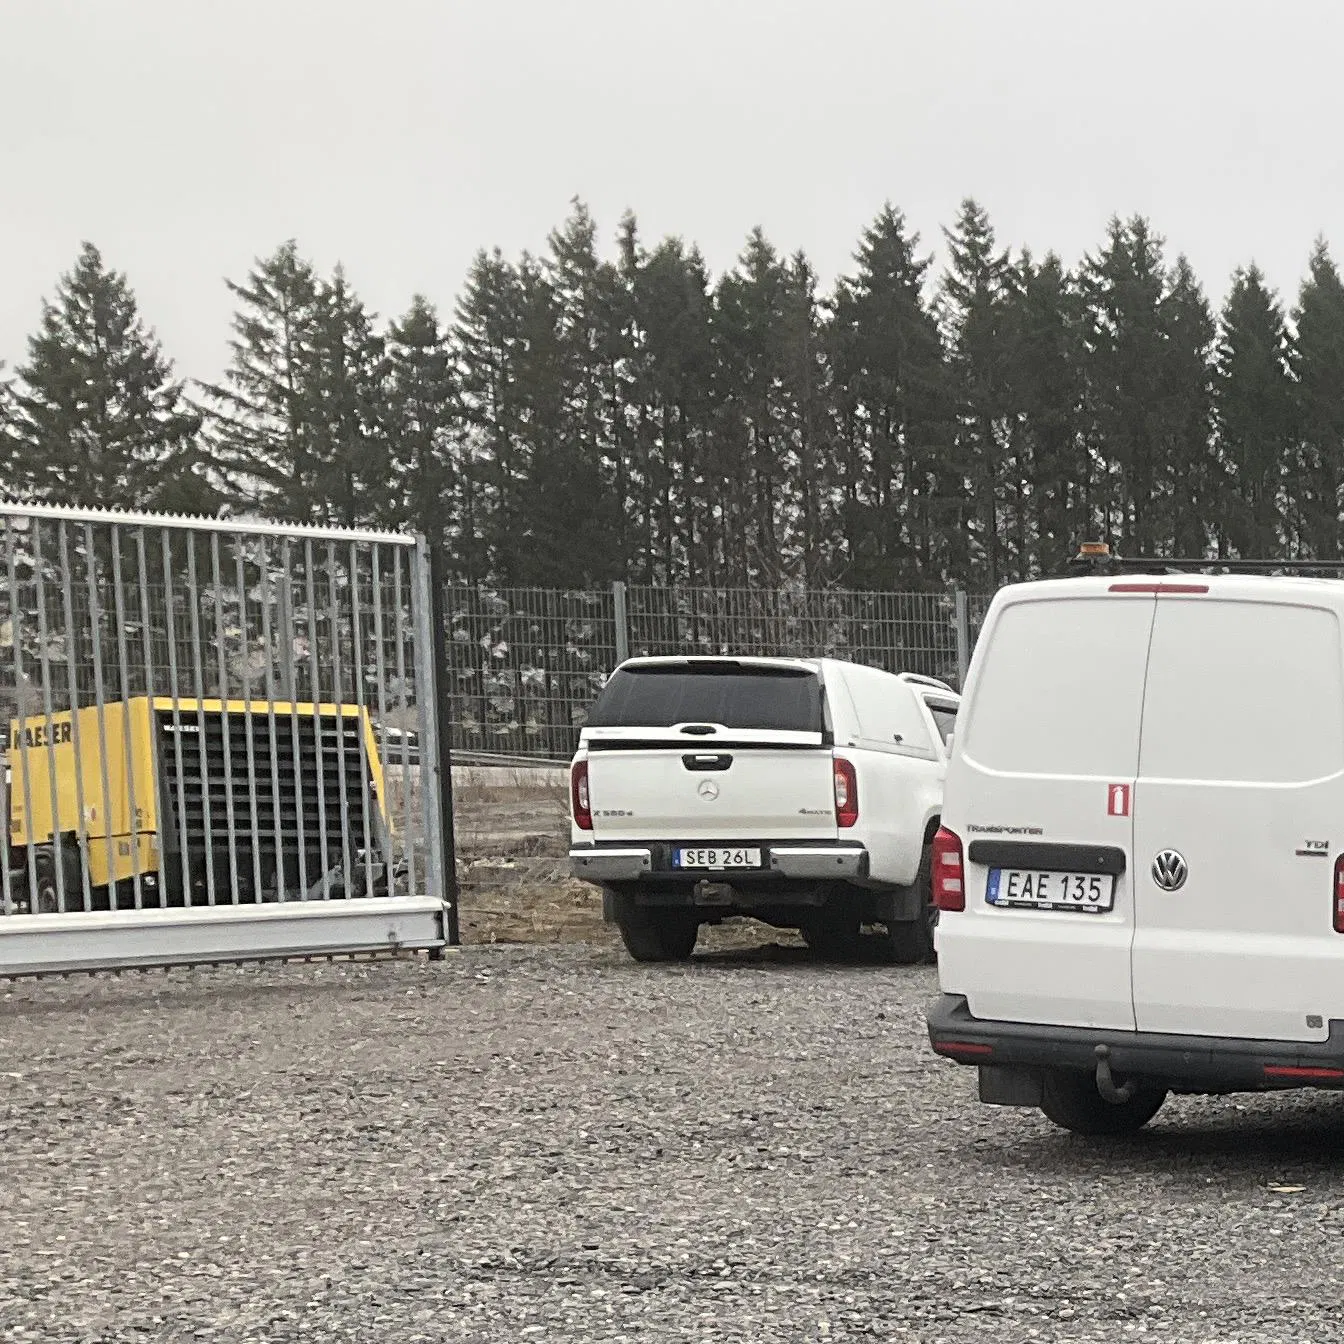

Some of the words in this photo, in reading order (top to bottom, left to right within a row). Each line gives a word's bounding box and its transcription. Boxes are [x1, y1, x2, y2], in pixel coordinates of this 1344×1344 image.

[685, 850, 718, 865] SEB
[722, 851, 754, 866] 26L
[1006, 871, 1051, 900] EAE
[1060, 874, 1102, 903] 135
